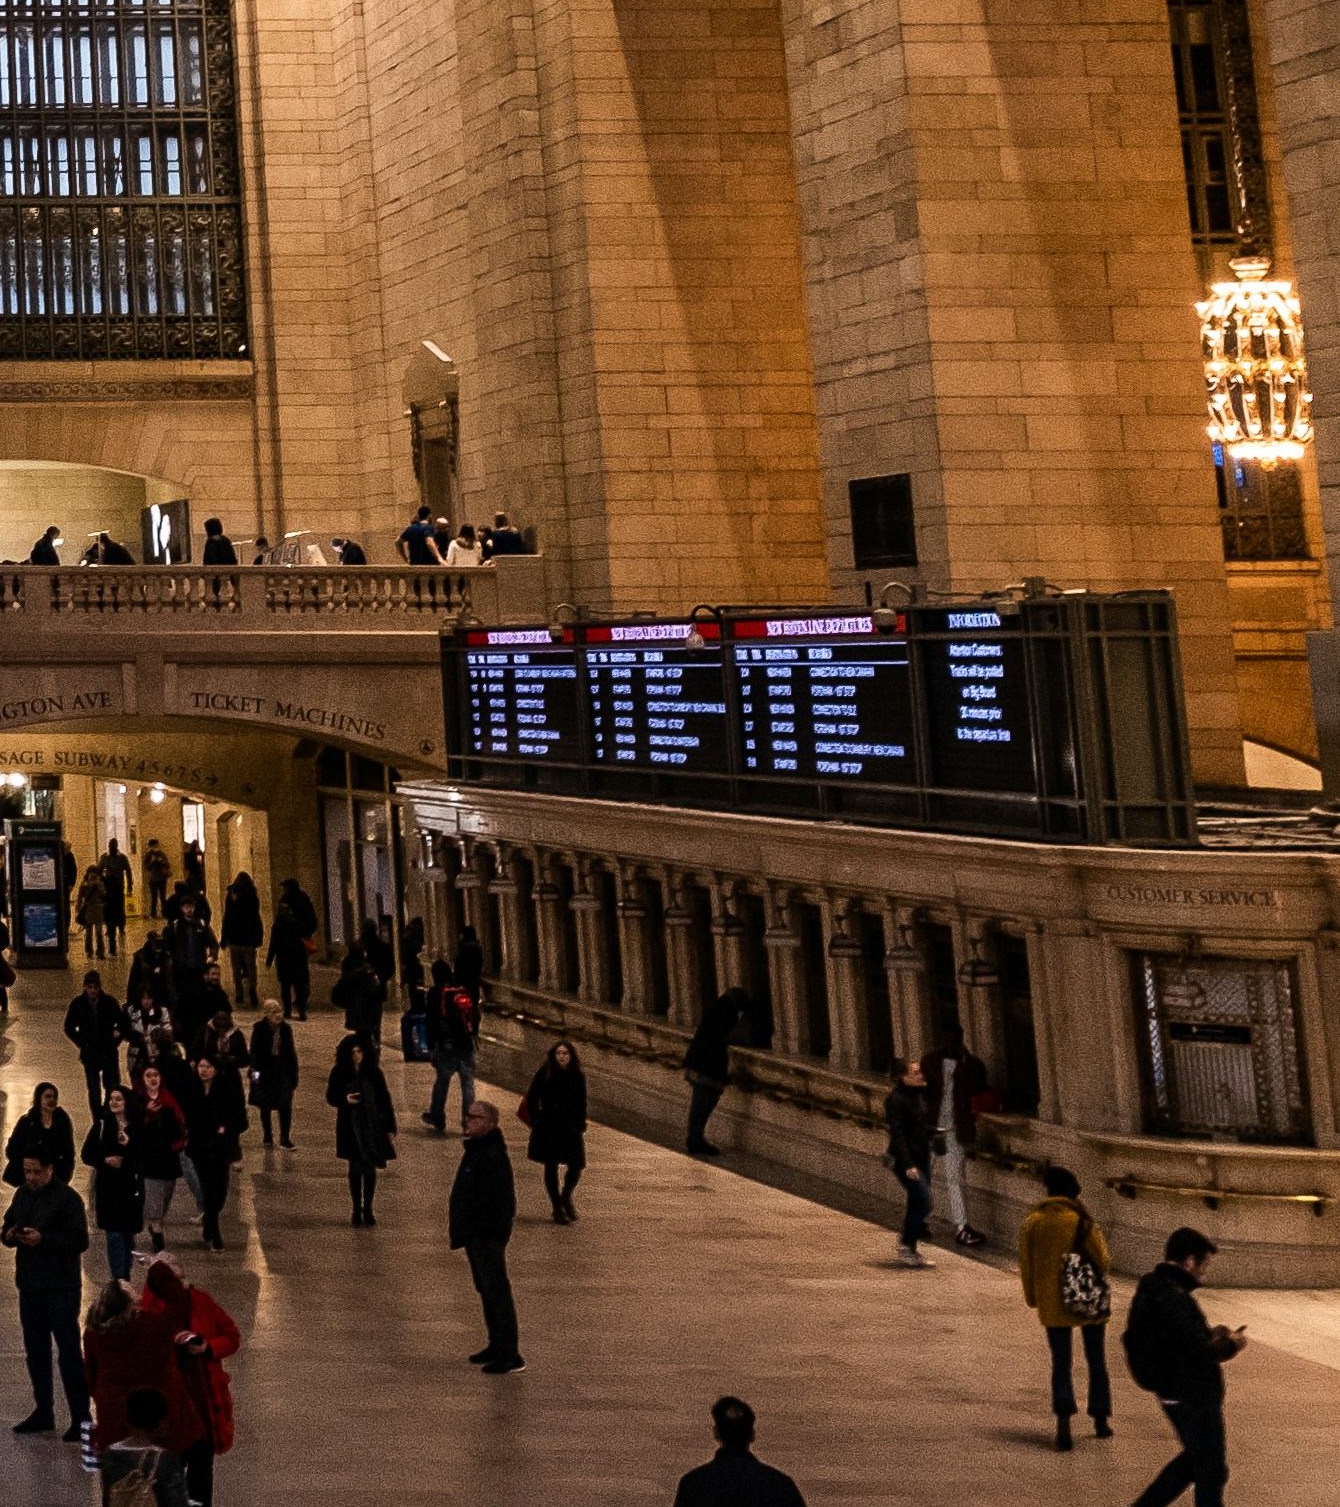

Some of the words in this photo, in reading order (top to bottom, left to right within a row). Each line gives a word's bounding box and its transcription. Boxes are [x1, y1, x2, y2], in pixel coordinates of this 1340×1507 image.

[73, 691, 112, 710] AVE
[191, 692, 265, 714] TICKET
[274, 701, 386, 740] MACHINES
[54, 752, 132, 770] SUBWAY
[1107, 886, 1196, 904] CUSTOMER
[1198, 890, 1277, 907] SERVICE
